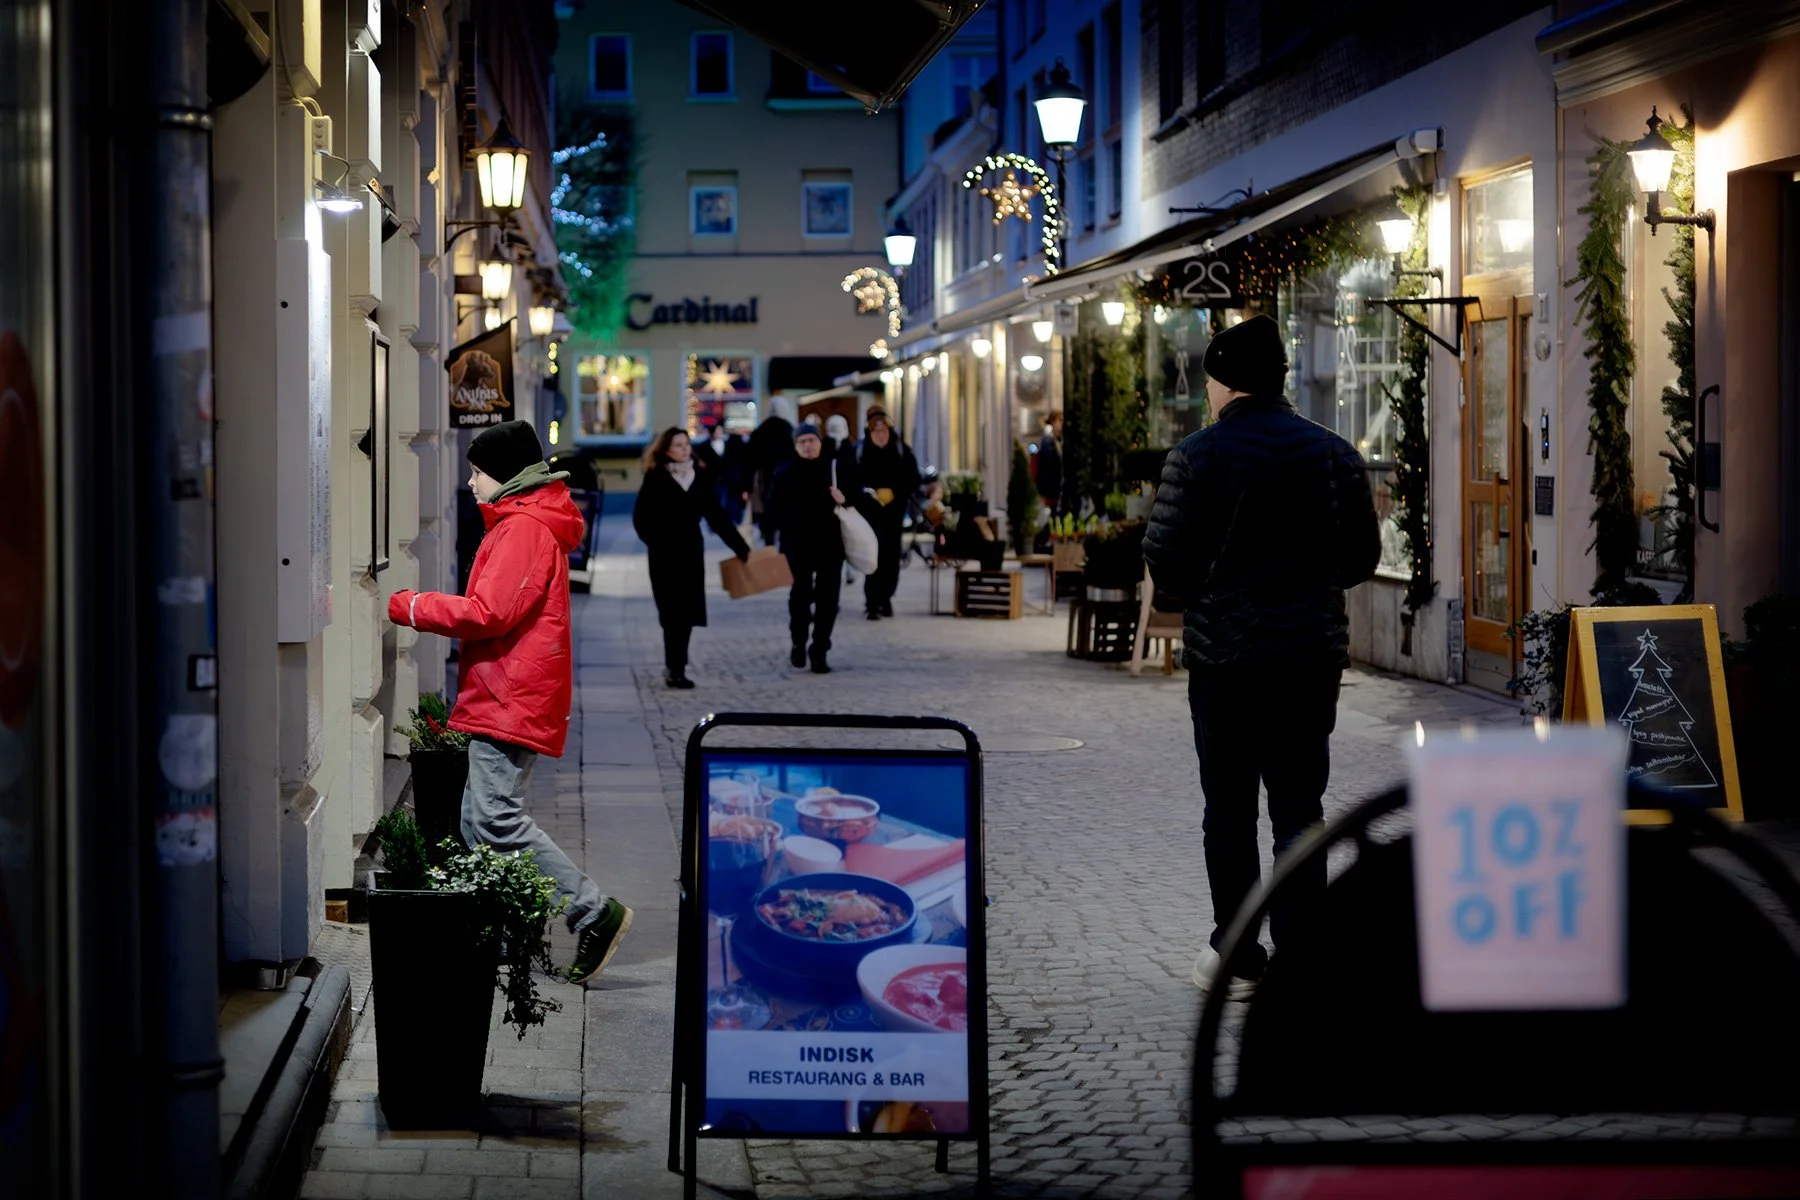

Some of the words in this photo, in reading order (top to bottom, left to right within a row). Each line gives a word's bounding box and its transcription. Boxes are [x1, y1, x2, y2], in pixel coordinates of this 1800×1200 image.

[625, 293, 758, 330] Cardinal
[455, 386, 499, 403] ANUBIS
[459, 413, 489, 425] DROP
[490, 413, 503, 424] IN
[1452, 869, 1588, 944] OFF
[799, 1046, 875, 1063] INDISK
[749, 1070, 867, 1087] RESTAURANG
[872, 1072, 885, 1086] &
[890, 1072, 925, 1087] BAR
